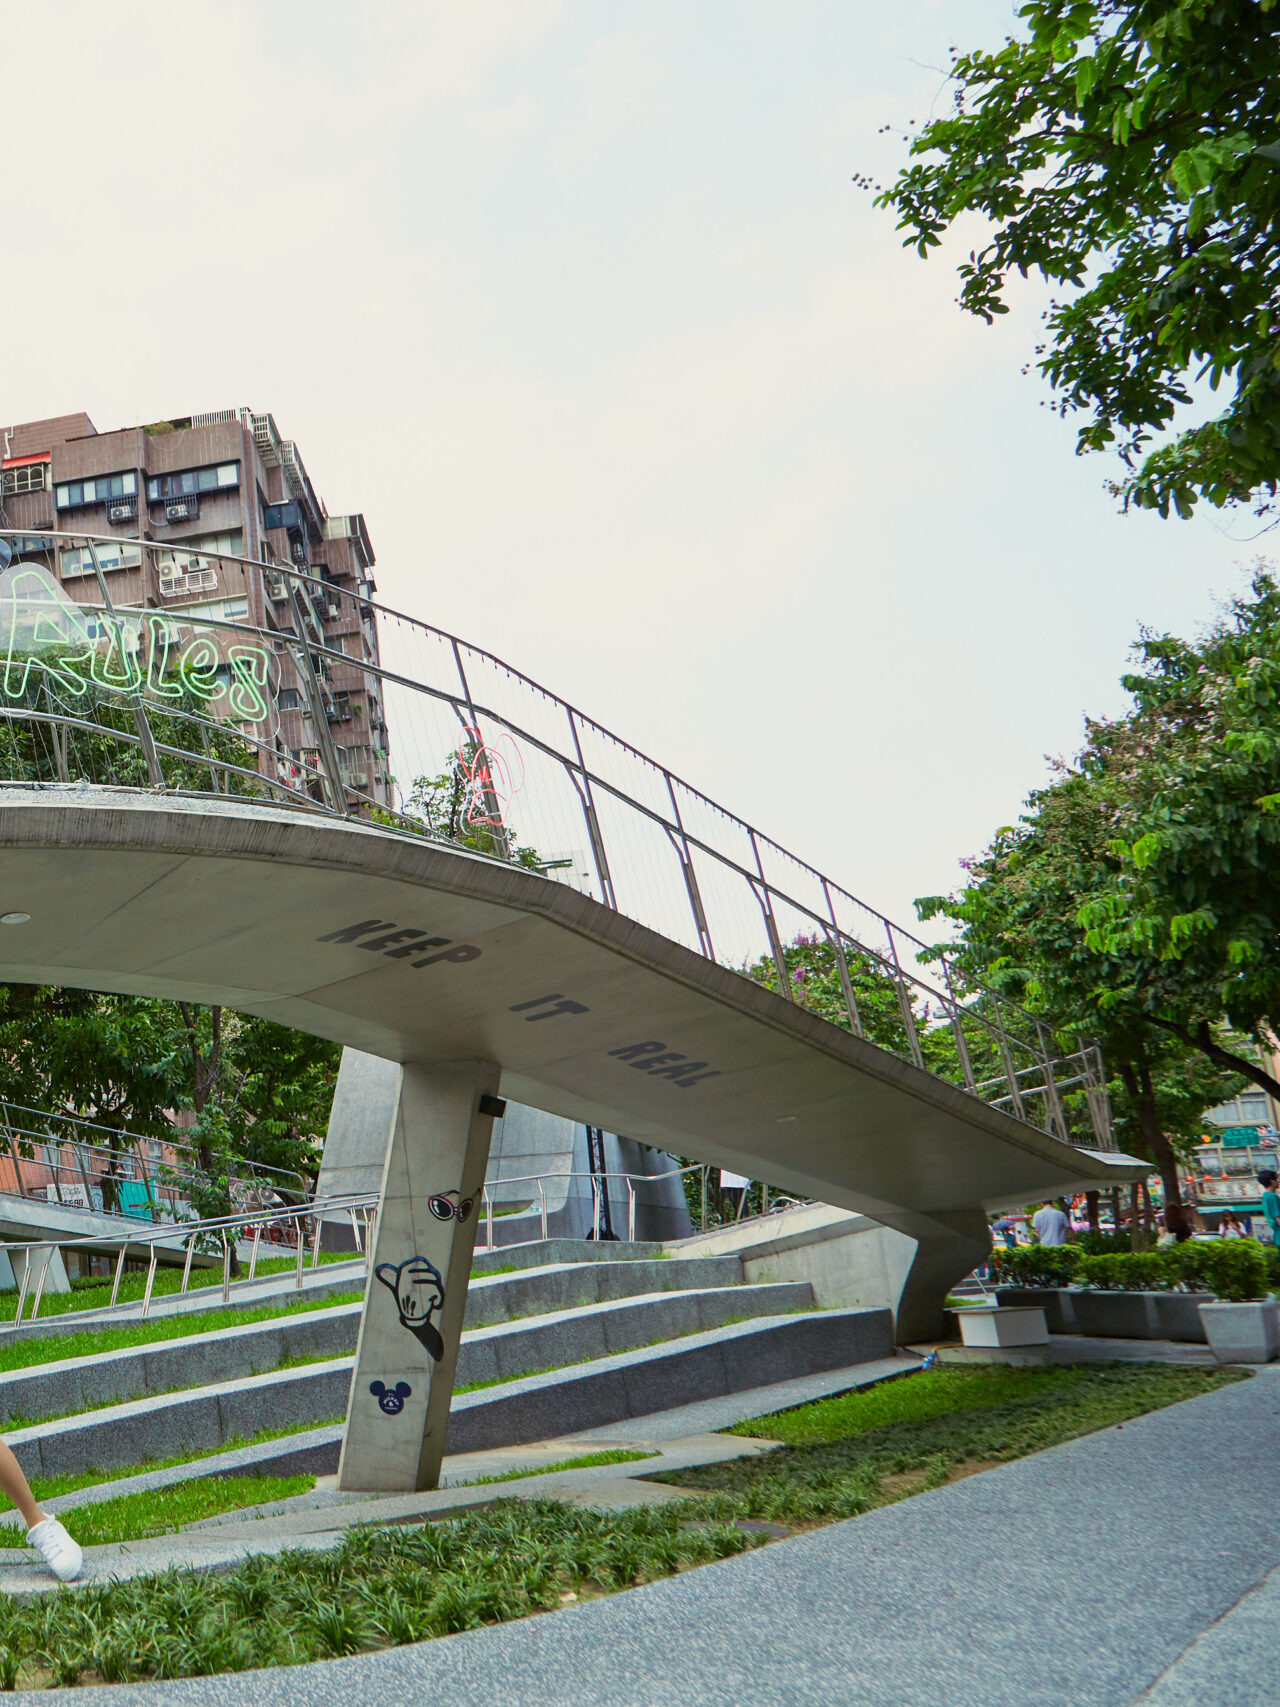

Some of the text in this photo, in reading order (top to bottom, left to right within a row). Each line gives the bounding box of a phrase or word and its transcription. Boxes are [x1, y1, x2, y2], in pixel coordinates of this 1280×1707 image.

[315, 919, 721, 1089] KEEP IT REAL
